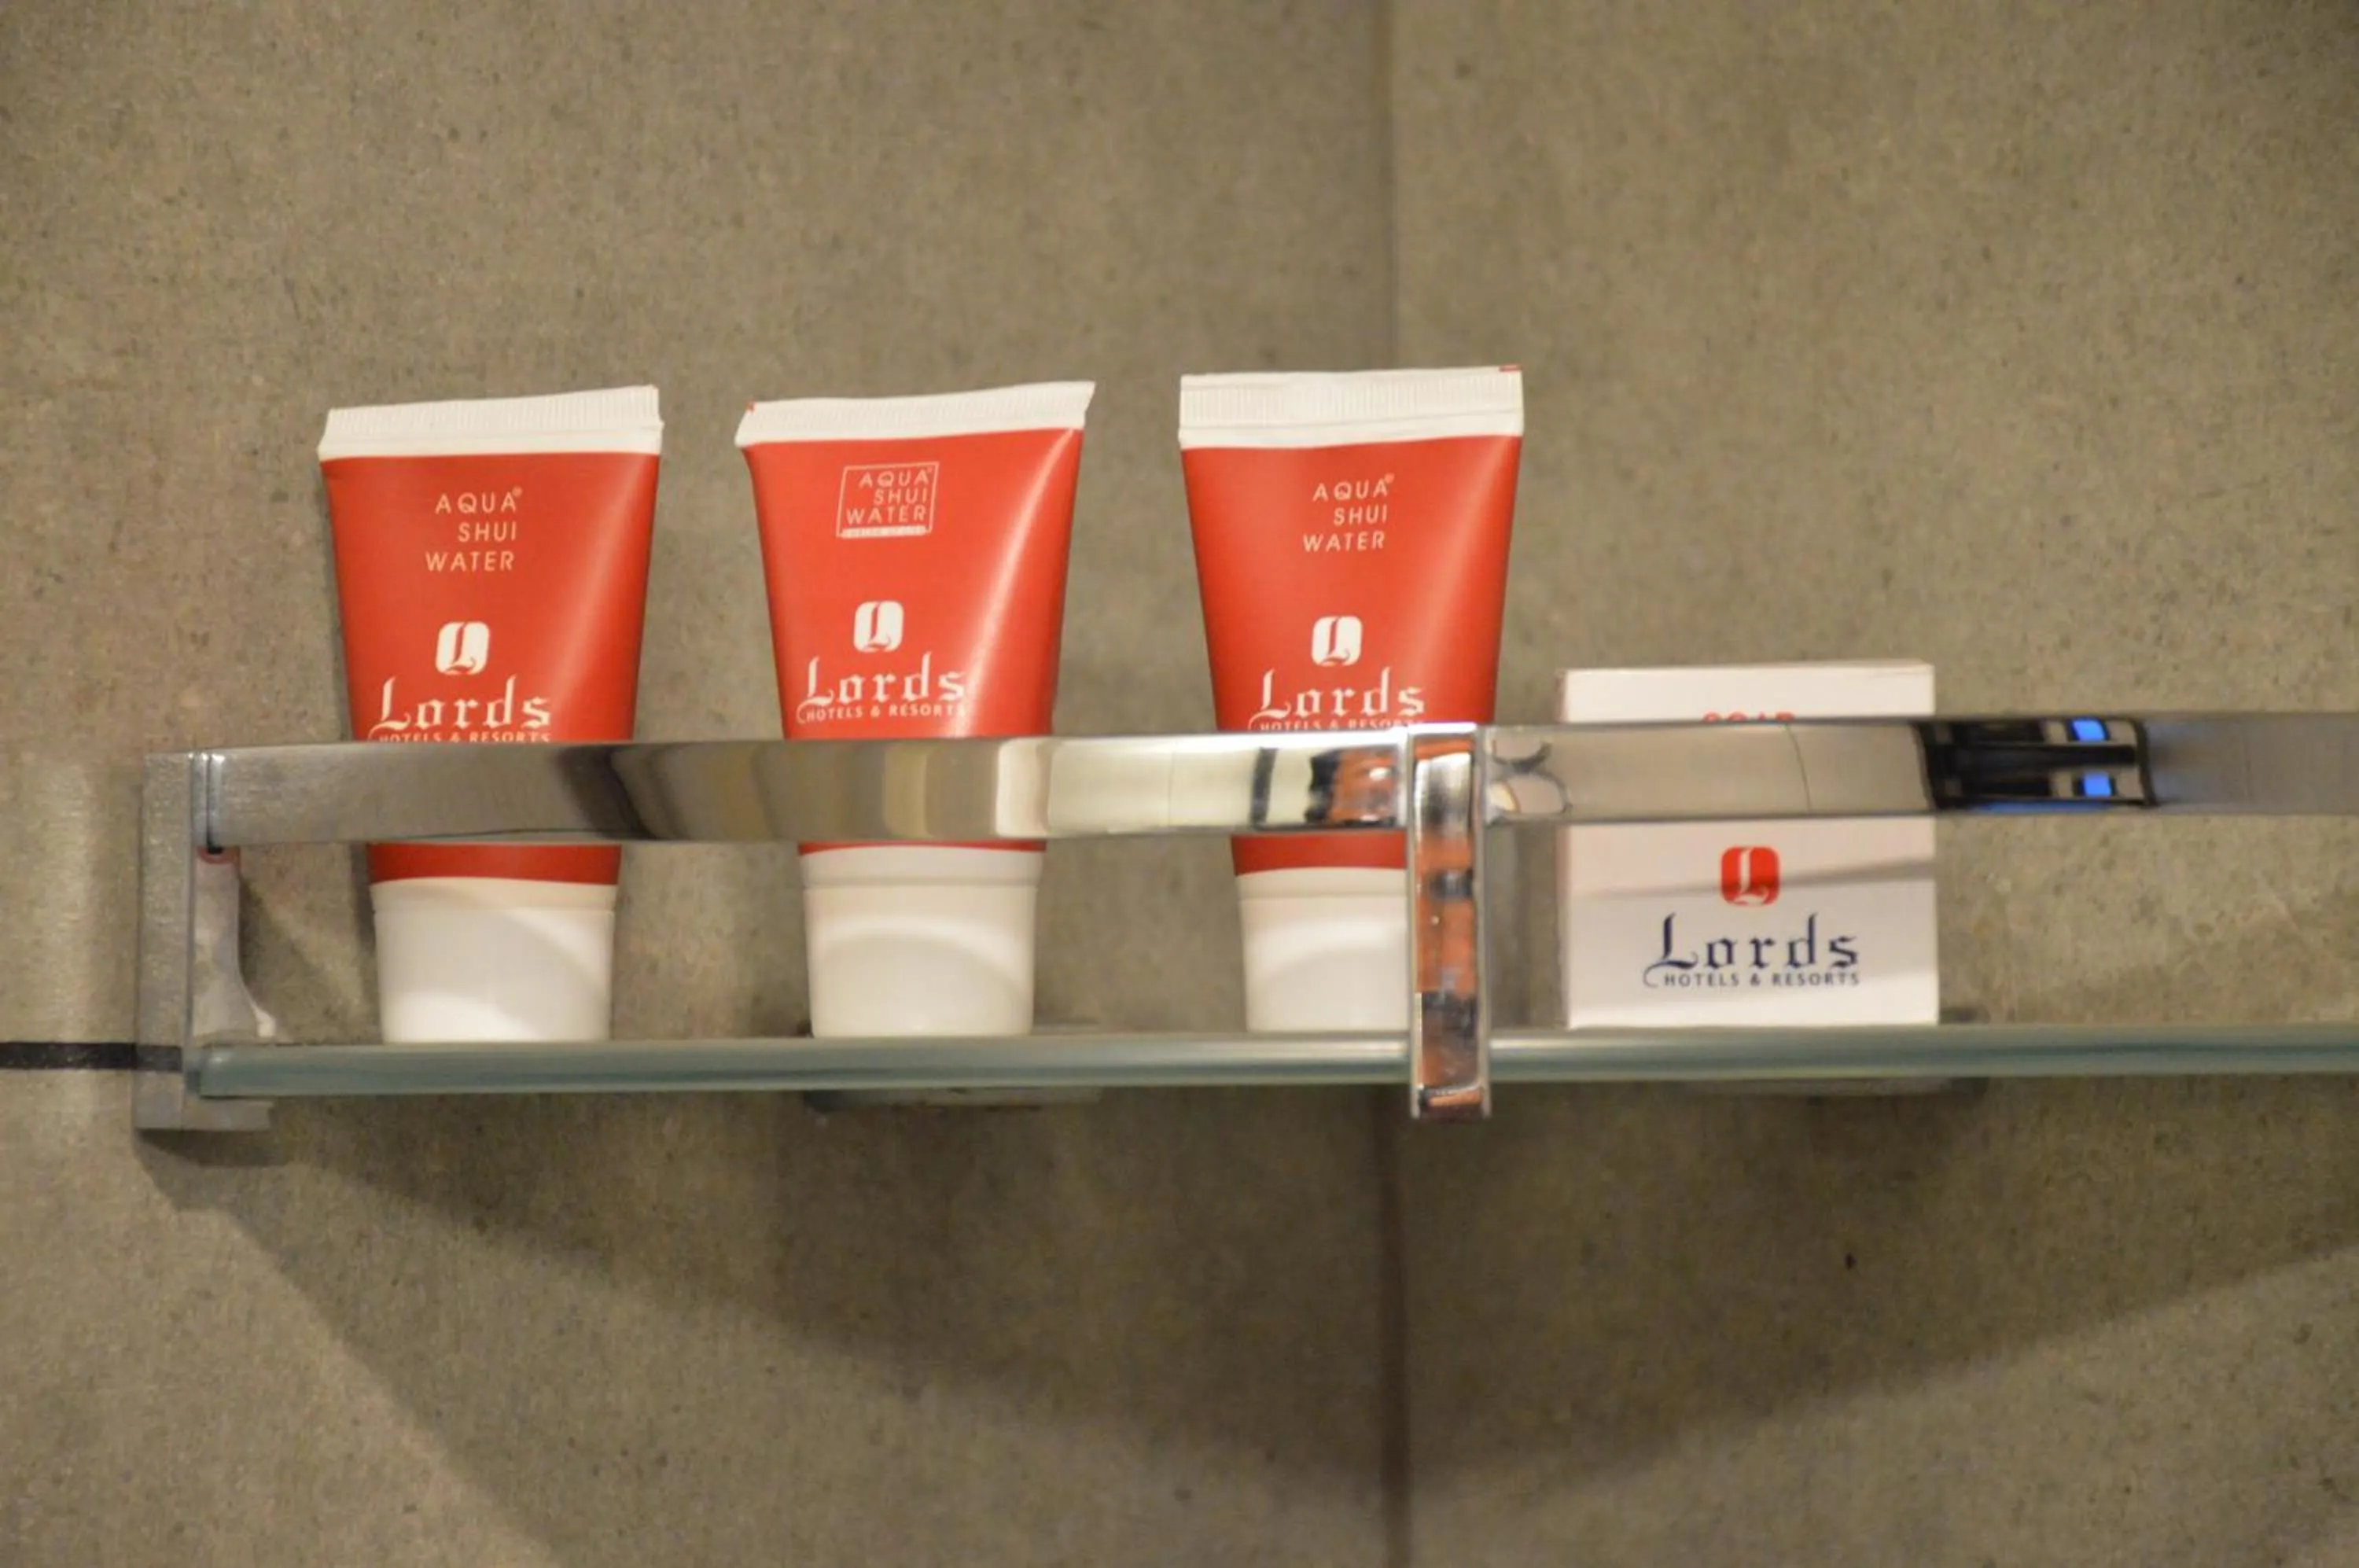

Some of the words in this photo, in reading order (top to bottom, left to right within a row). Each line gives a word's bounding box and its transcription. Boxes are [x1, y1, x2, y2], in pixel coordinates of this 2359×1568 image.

[858, 469, 929, 488] AQUA
[873, 488, 928, 505] SHUI
[846, 504, 927, 525] WATER
[1333, 504, 1388, 527] SHUI
[457, 521, 517, 543] SHUI
[1303, 530, 1386, 552] WATER
[425, 551, 515, 572] WATER
[796, 651, 967, 723] Lords
[367, 674, 552, 742] Lords
[1249, 666, 1425, 731] Lords
[806, 706, 863, 723] HOTELS
[378, 732, 442, 743] HOTELS
[469, 731, 551, 743] RESORTS
[1643, 911, 1860, 988] Lords
[1664, 972, 1740, 987] HOTELS
[1750, 972, 1761, 987] &
[1772, 972, 1860, 987] RESORTS
